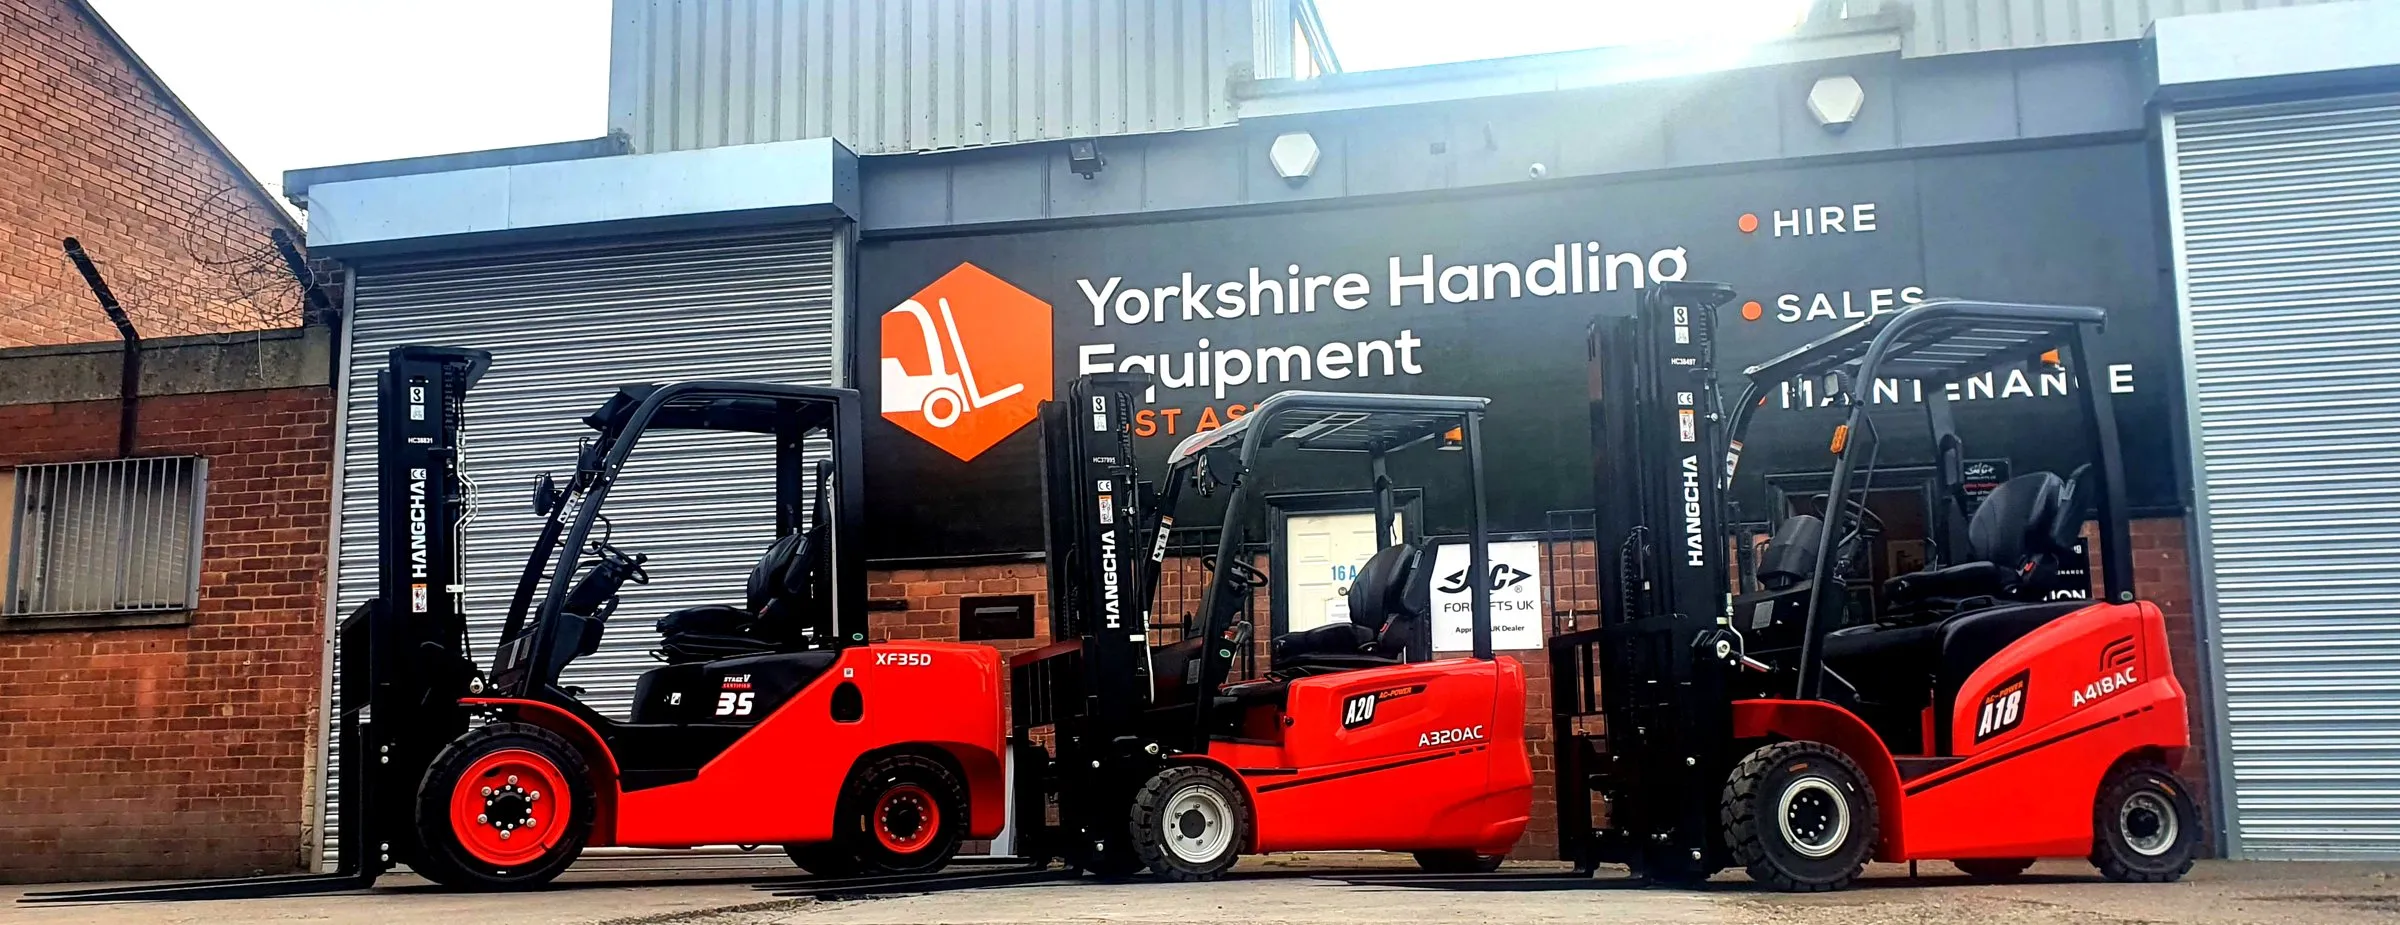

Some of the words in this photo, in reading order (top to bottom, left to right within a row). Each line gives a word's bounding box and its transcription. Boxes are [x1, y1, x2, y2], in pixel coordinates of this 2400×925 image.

[1773, 203, 1876, 237] HIRE
[1076, 263, 1371, 327] Yorkshire
[1388, 240, 1688, 307] Handling
[1776, 286, 1924, 323] SALES
[1078, 328, 1423, 404] Equipment
[1195, 403, 1259, 433] AS
[1682, 454, 1704, 567] HANGCHA
[410, 480, 427, 578] HANGCHA
[1101, 529, 1120, 629] HANGCHA
[1331, 565, 1346, 581] 16
[1348, 564, 1357, 580] A
[1516, 600, 1535, 611] UK
[875, 652, 932, 666] XF35D
[715, 691, 755, 716] 35
[2071, 666, 2138, 708] A418AC
[1344, 694, 1375, 725] A20
[1978, 690, 2022, 738] A18
[1418, 725, 1484, 748] A320AC
